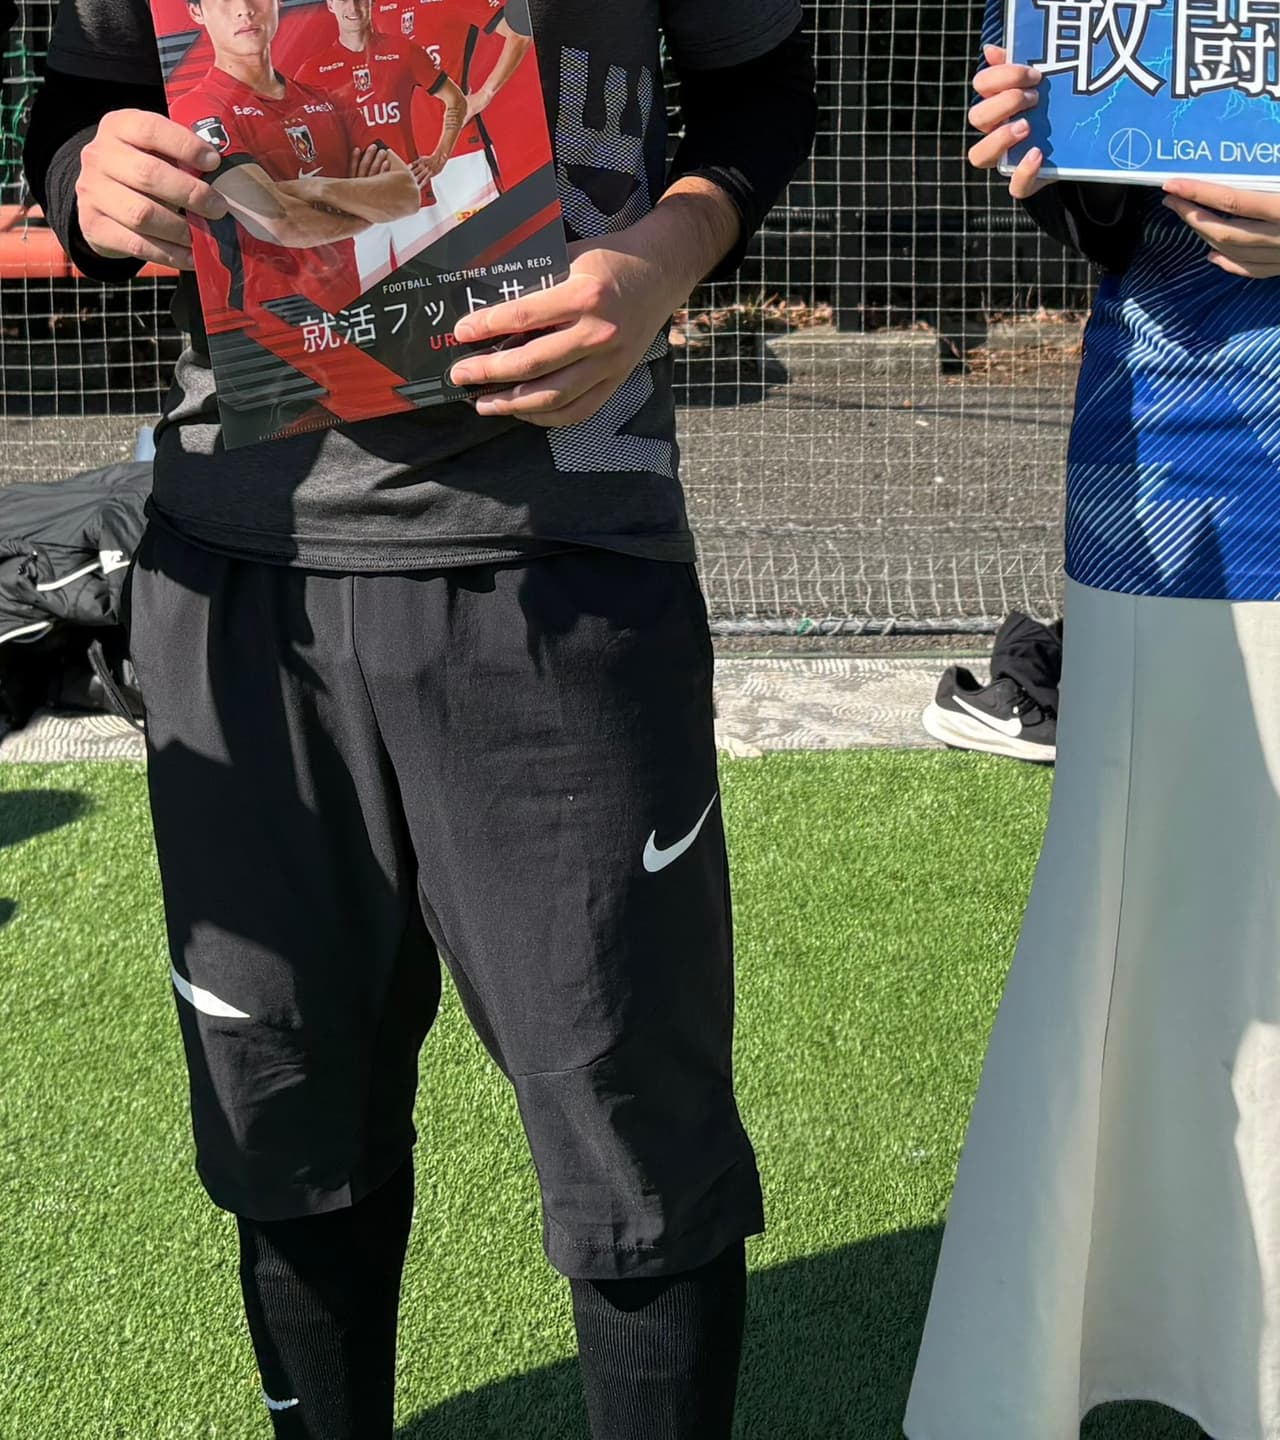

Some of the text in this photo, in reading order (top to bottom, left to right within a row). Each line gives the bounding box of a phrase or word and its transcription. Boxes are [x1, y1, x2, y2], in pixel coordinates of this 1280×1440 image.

[358, 101, 401, 127] LUS
[382, 256, 552, 295] FOOTBALL TOGETHER URAWA REDS
[546, 45, 674, 478] NKE
